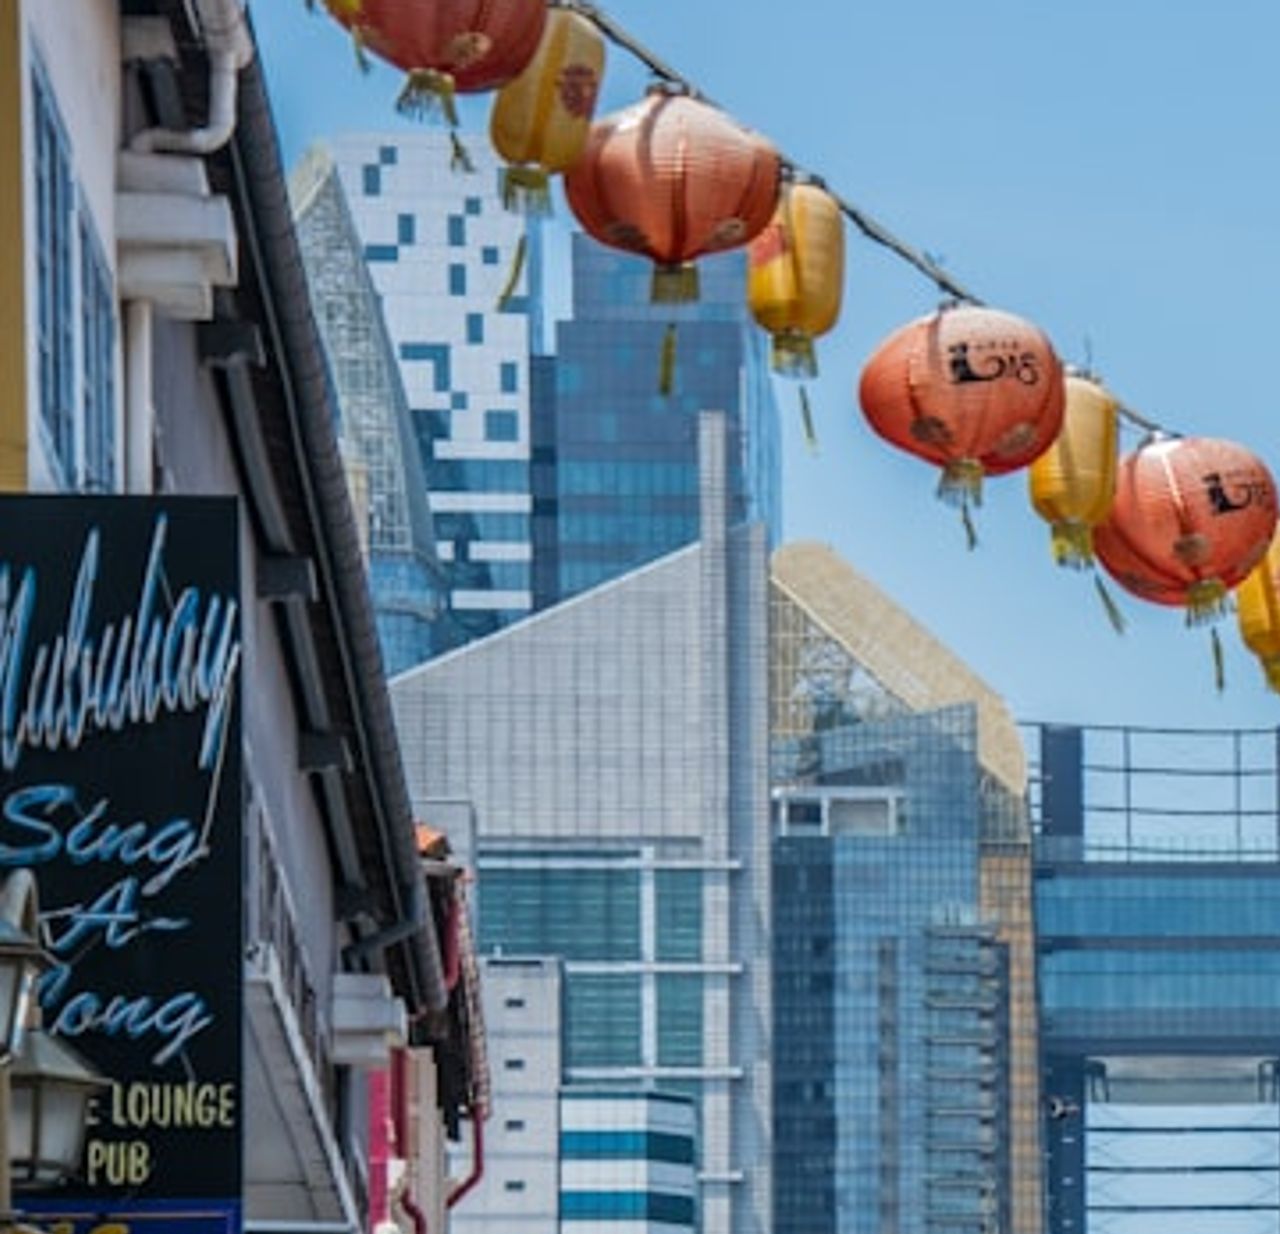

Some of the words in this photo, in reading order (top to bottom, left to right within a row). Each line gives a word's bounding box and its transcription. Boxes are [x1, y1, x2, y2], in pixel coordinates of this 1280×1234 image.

[0, 785, 207, 896] Sing
[112, 1082, 236, 1128] LOUNGE
[87, 1140, 150, 1186] PUB
